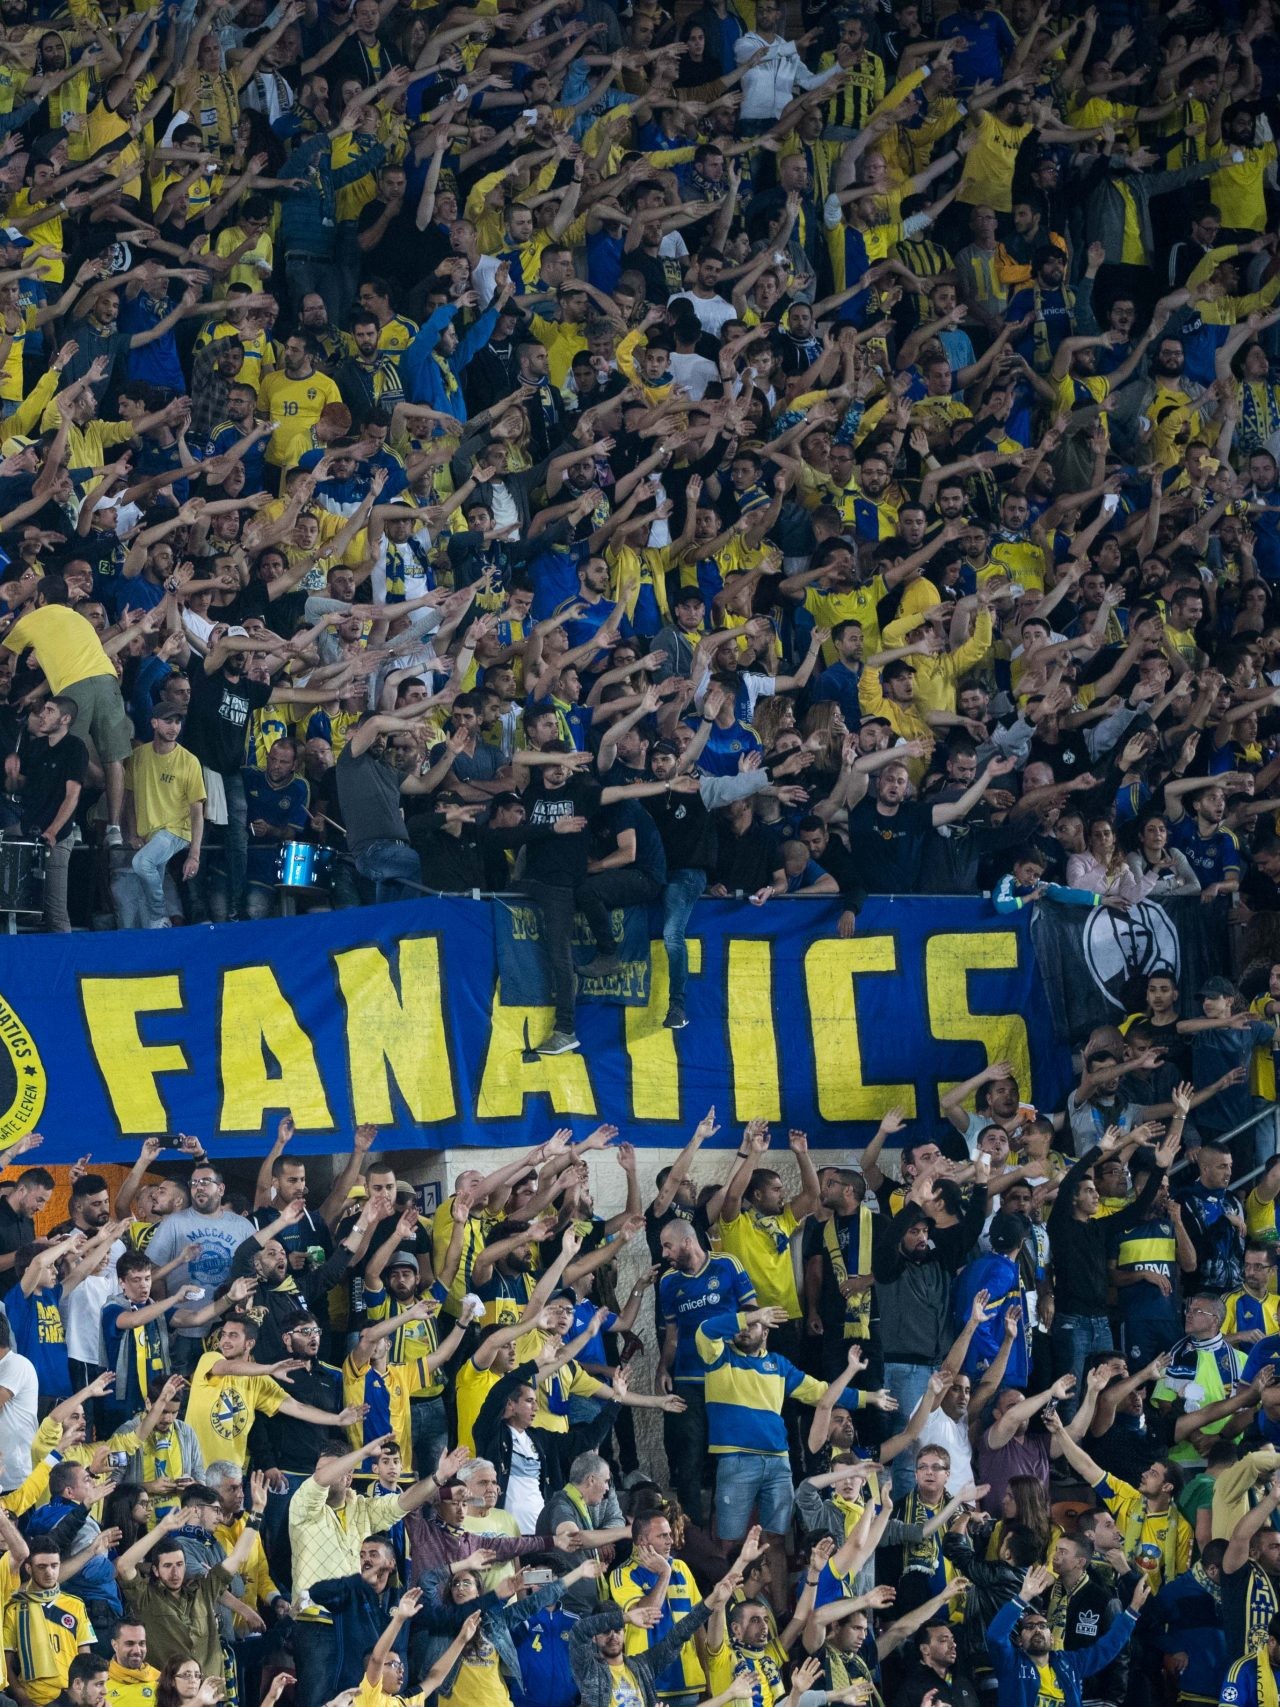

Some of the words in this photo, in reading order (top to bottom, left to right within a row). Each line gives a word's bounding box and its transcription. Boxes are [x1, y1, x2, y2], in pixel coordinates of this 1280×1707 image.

[284, 401, 298, 416] 10
[160, 773, 175, 783] MF
[80, 930, 1032, 1134] FANATICS
[17, 1084, 38, 1124] ELEVEN
[187, 1228, 237, 1246] MACCABI
[678, 1296, 707, 1313] unicef
[531, 1633, 543, 1652] 4
